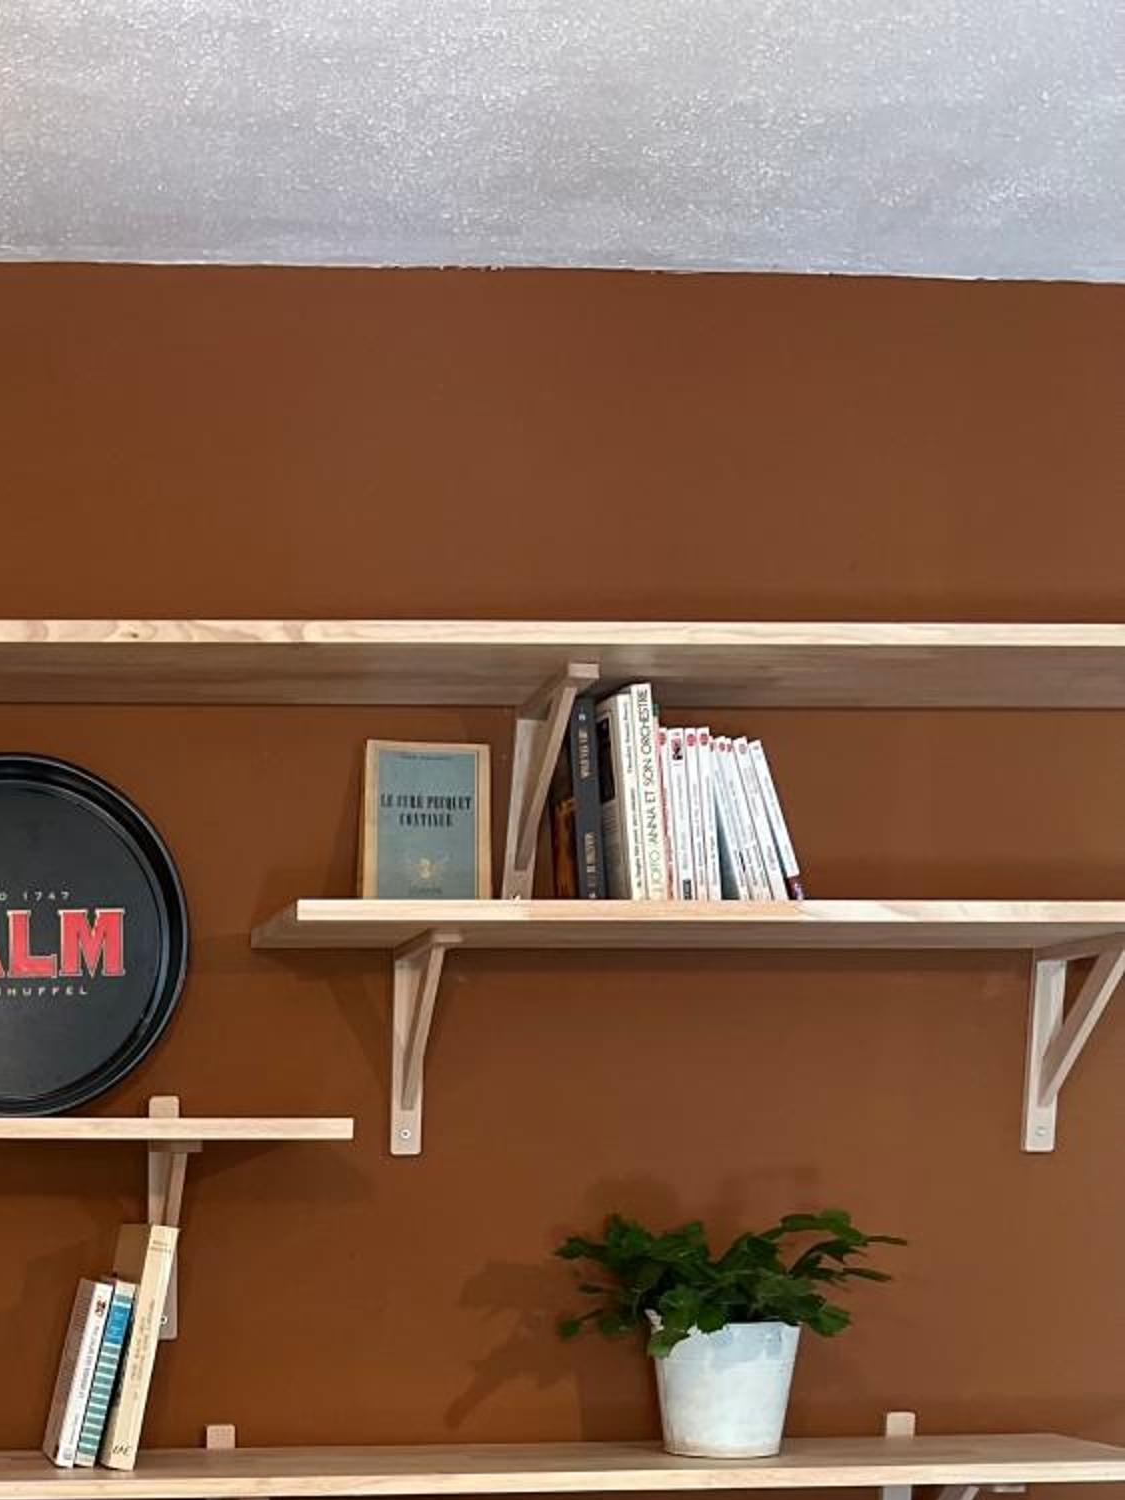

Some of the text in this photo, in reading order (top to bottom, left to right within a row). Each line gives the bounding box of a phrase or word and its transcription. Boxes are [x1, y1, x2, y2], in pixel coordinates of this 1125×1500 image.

[636, 689, 653, 755] ORCHESTRE
[642, 758, 654, 787] SON
[644, 791, 656, 803] ET
[645, 806, 658, 843] ANNA
[23, 891, 70, 901] 1747
